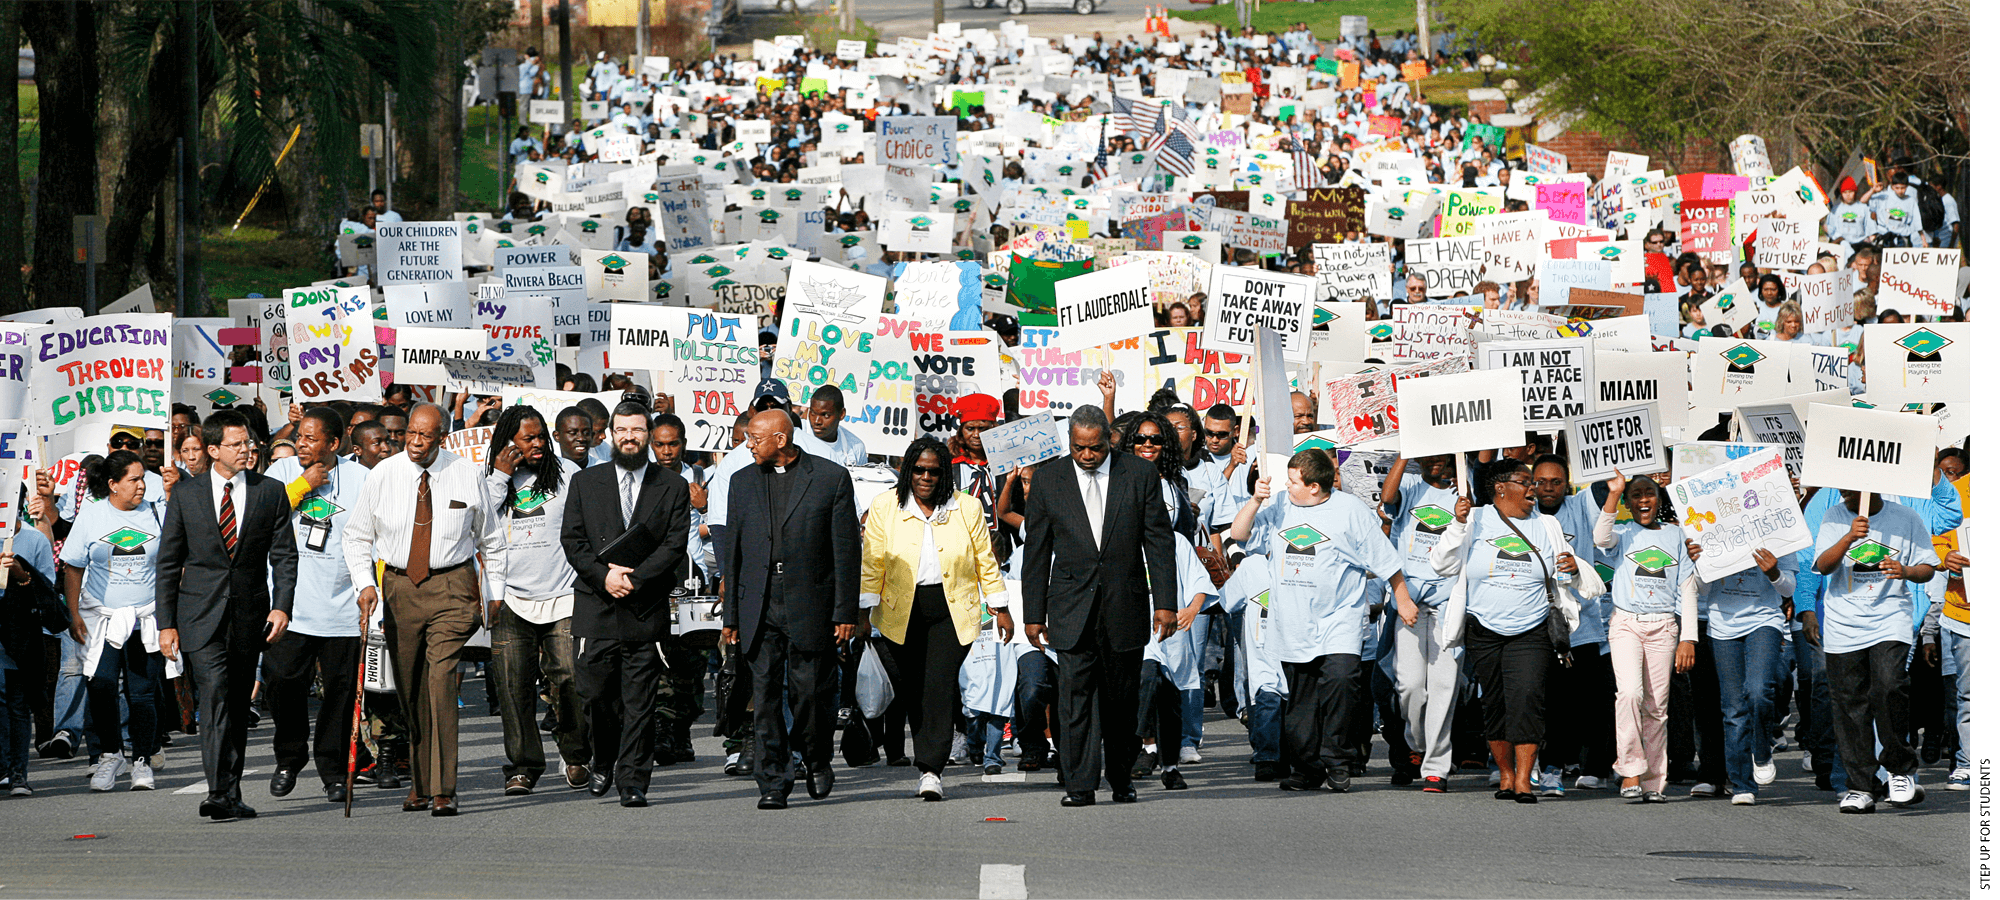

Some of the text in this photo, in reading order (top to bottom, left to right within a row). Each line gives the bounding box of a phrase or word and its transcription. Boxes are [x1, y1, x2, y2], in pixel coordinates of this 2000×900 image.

[1142, 195, 1169, 204] VOTE
[1685, 206, 1725, 220] VOTE
[379, 226, 458, 237] OUR CHILDREN
[1493, 230, 1521, 245] HAVE
[1526, 229, 1535, 240] A
[1691, 222, 1719, 234] FOR
[1772, 221, 1800, 235] VOTE
[398, 241, 440, 252] ARE THE
[1436, 240, 1482, 261] HAVE
[1694, 237, 1714, 249] MY
[1761, 236, 1810, 250] FOR MY
[400, 255, 440, 266] FUTURE
[507, 252, 557, 265] POWER
[1484, 250, 1536, 276] DREAM
[1759, 253, 1807, 266] FUTURE
[1884, 252, 1959, 266] I LOVE MY
[387, 269, 453, 281] GENERATION
[505, 272, 583, 288] RIVIERA BEACH
[1427, 268, 1483, 289] DREAM
[1804, 280, 1832, 297] VOTE
[1838, 274, 1852, 290] FOR
[424, 291, 429, 303] I
[1244, 280, 1286, 297] DON'T
[1881, 272, 1954, 314] SCHOLARSHIP
[322, 295, 366, 321] TAKE
[478, 301, 507, 320] My
[1060, 286, 1150, 328] FT LAUDERDALE
[1222, 293, 1302, 317] TAKE AWAY
[1805, 302, 1854, 326] MY FUTURE
[406, 309, 453, 324] LOVE MY
[554, 314, 581, 326] EACH
[686, 312, 742, 342] PUT
[876, 316, 921, 338] OVE
[1220, 310, 1299, 333] MY CHILD'S
[293, 322, 353, 346] AWAY
[482, 323, 542, 339] FUTURE
[617, 327, 670, 348] TAMPA
[791, 318, 874, 353] I LOVE
[1228, 326, 1287, 348] FUTE
[39, 324, 167, 362] EDUCATION
[673, 338, 759, 365] POLITICS
[909, 332, 944, 352] WE
[1149, 330, 1177, 366] I
[298, 343, 341, 370] MY
[402, 348, 449, 365] TAMPA
[486, 343, 515, 363] IS
[795, 341, 836, 366] MY
[1020, 346, 1082, 367] TURN
[1503, 350, 1571, 367] I AM NOT
[56, 356, 165, 387] THROUGH
[298, 348, 379, 398] DREAMS
[678, 364, 746, 384] ASIDE
[914, 354, 976, 376] VOTE
[1534, 367, 1582, 384] A FACE
[914, 374, 959, 395] FOR
[1020, 366, 1080, 386] VOTE
[876, 382, 915, 404] ME
[1562, 386, 1573, 401] A
[1600, 379, 1658, 402] MIAMI
[51, 385, 167, 426] CHOICE
[693, 389, 741, 416] FOR
[1430, 398, 1493, 428] MIAMI
[1581, 415, 1643, 445] VOTE FOR
[1763, 416, 1783, 430] IT'S
[1779, 431, 1805, 445] TURN
[1581, 438, 1653, 471] MY FUTURE
[1837, 435, 1902, 466] MIAMI
[366, 646, 378, 683] YAMAHA
